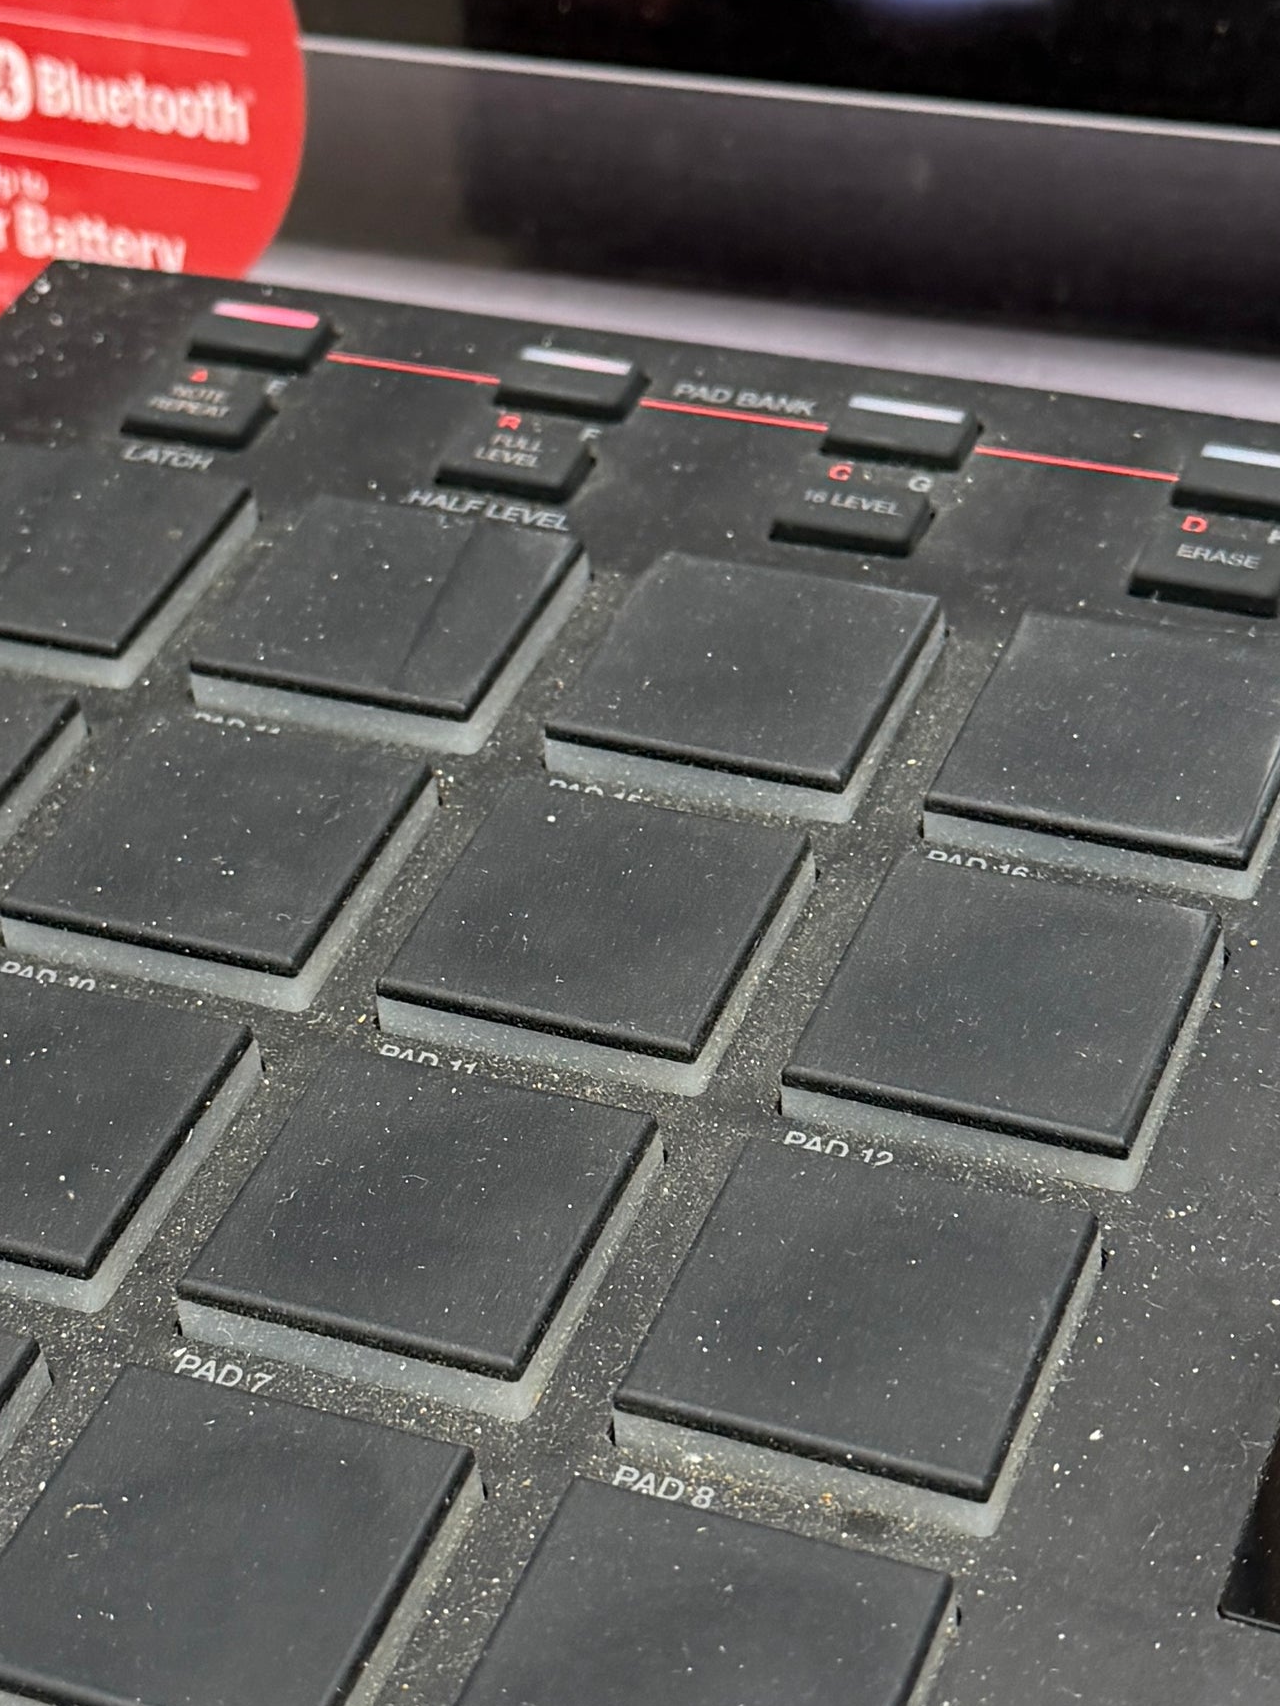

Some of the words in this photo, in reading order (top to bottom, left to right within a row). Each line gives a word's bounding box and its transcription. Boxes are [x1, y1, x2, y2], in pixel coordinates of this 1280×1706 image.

[34, 51, 250, 146] Bluetooth
[12, 197, 187, 274] Battery
[673, 382, 733, 405] PAD
[735, 387, 819, 417] BANK
[122, 444, 216, 472] LATCH
[474, 445, 540, 469] LEVEL
[406, 490, 486, 514] HALF
[485, 503, 570, 533] LEVEL
[830, 492, 904, 517] LEVEL
[1180, 514, 1209, 534] D
[1176, 542, 1262, 571] ERASE
[174, 1353, 245, 1390] PAD
[249, 1370, 275, 1393] 7
[613, 1465, 688, 1502] PAD
[691, 1486, 716, 1510] 8
